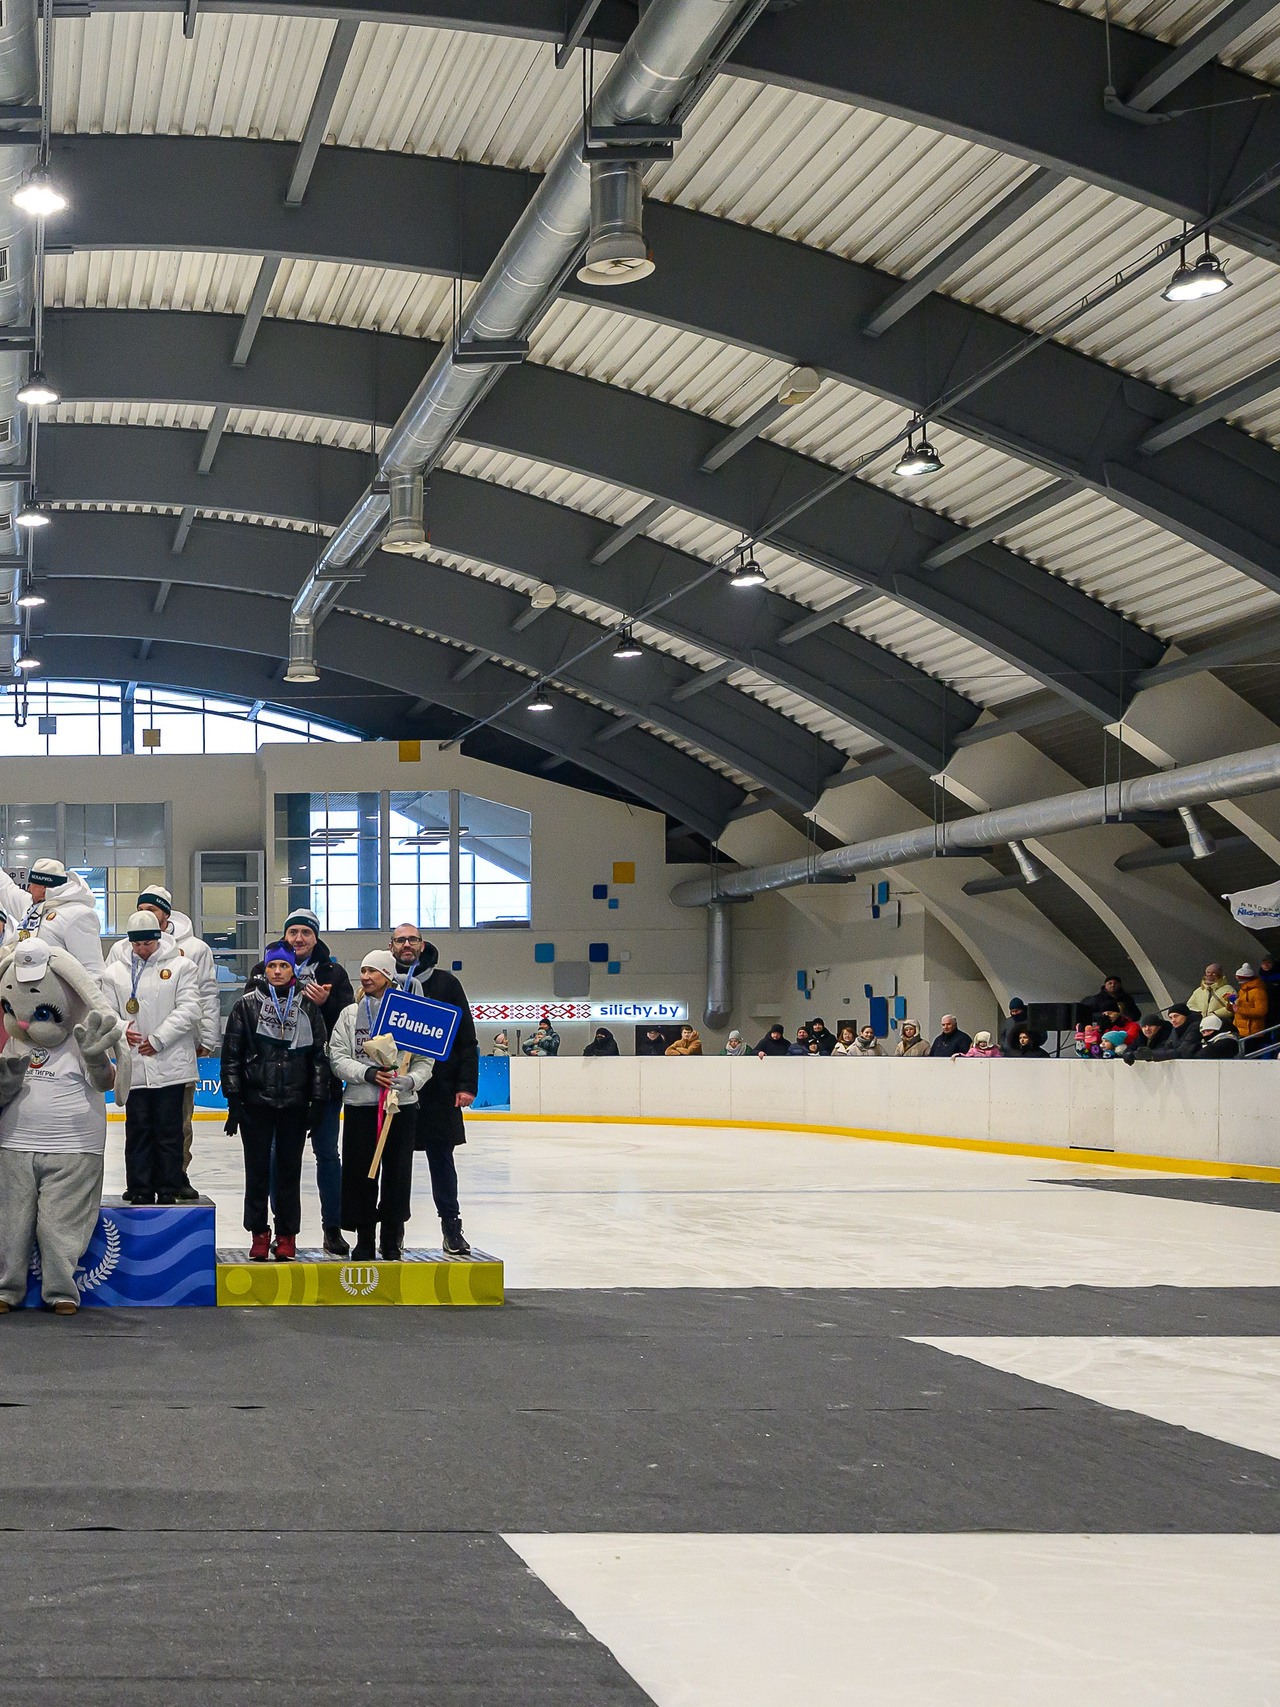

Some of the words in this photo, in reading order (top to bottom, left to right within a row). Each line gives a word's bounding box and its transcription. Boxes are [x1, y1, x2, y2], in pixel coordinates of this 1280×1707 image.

[600, 1004, 679, 1018] silichy.by
[388, 1010, 444, 1039] Единые
[35, 1069, 56, 1077] ТИГРЫ
[346, 1267, 373, 1285] III
